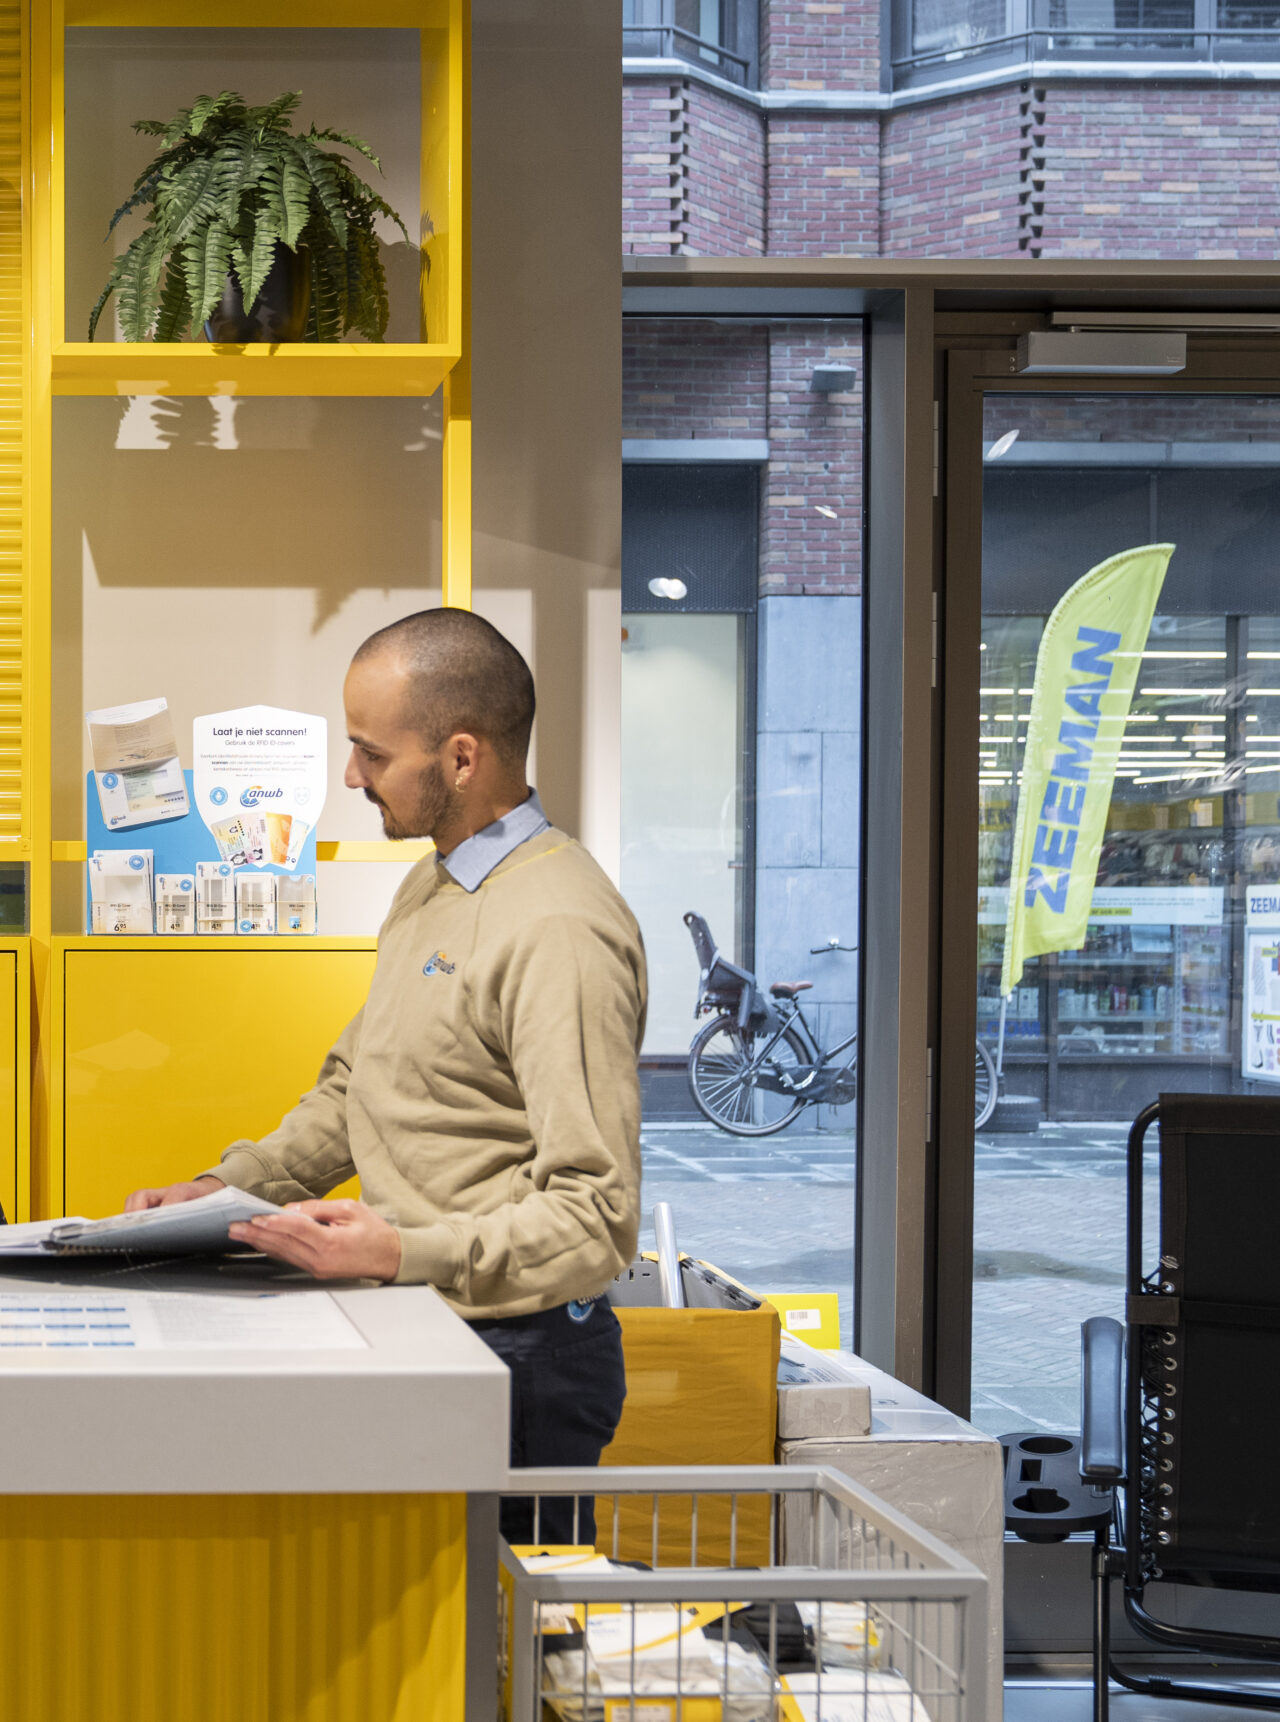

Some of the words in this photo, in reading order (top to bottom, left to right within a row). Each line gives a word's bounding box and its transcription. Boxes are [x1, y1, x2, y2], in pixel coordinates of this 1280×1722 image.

[212, 727, 233, 736] Laat
[235, 727, 244, 738] je
[246, 727, 264, 736] niet
[265, 727, 307, 736] scannen!
[1023, 625, 1122, 915] ZEEMAN
[249, 787, 284, 798] anwb
[1251, 897, 1280, 914] ZEEM
